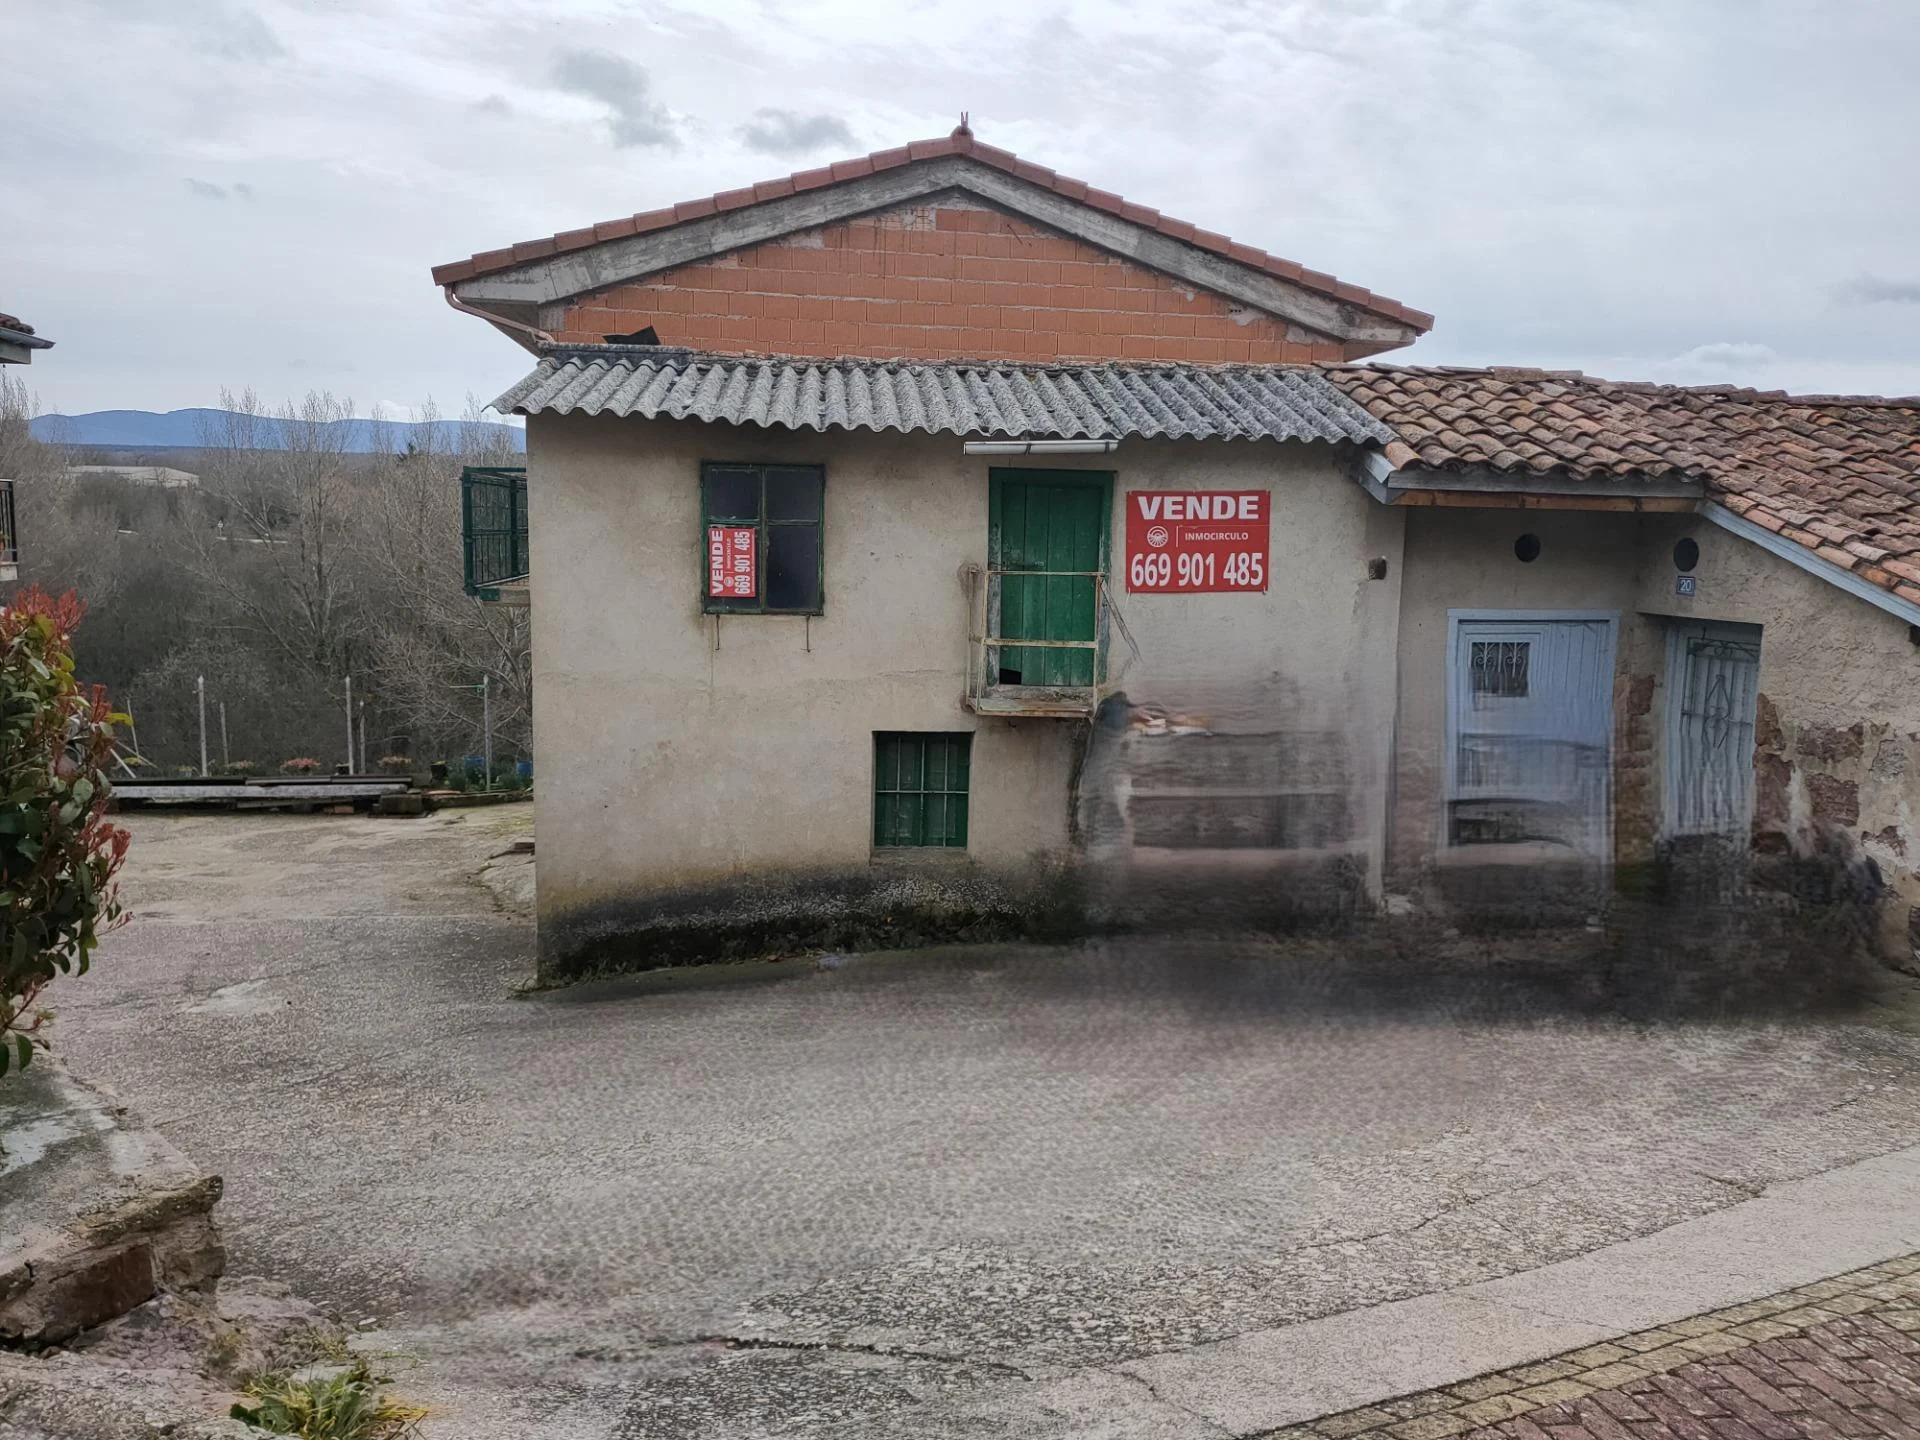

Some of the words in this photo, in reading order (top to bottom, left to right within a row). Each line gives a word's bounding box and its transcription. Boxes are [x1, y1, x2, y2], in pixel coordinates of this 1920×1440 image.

[1137, 495, 1260, 520] VENDE
[734, 531, 750, 551] 485
[1184, 532, 1249, 541] INMOCIRCULO
[711, 530, 724, 594] VENDE
[734, 554, 750, 573] 901
[1131, 552, 1171, 587] 669
[1177, 552, 1215, 587] 901
[1223, 552, 1263, 586] 485
[734, 574, 750, 594] 669
[1680, 579, 1692, 592] 20
